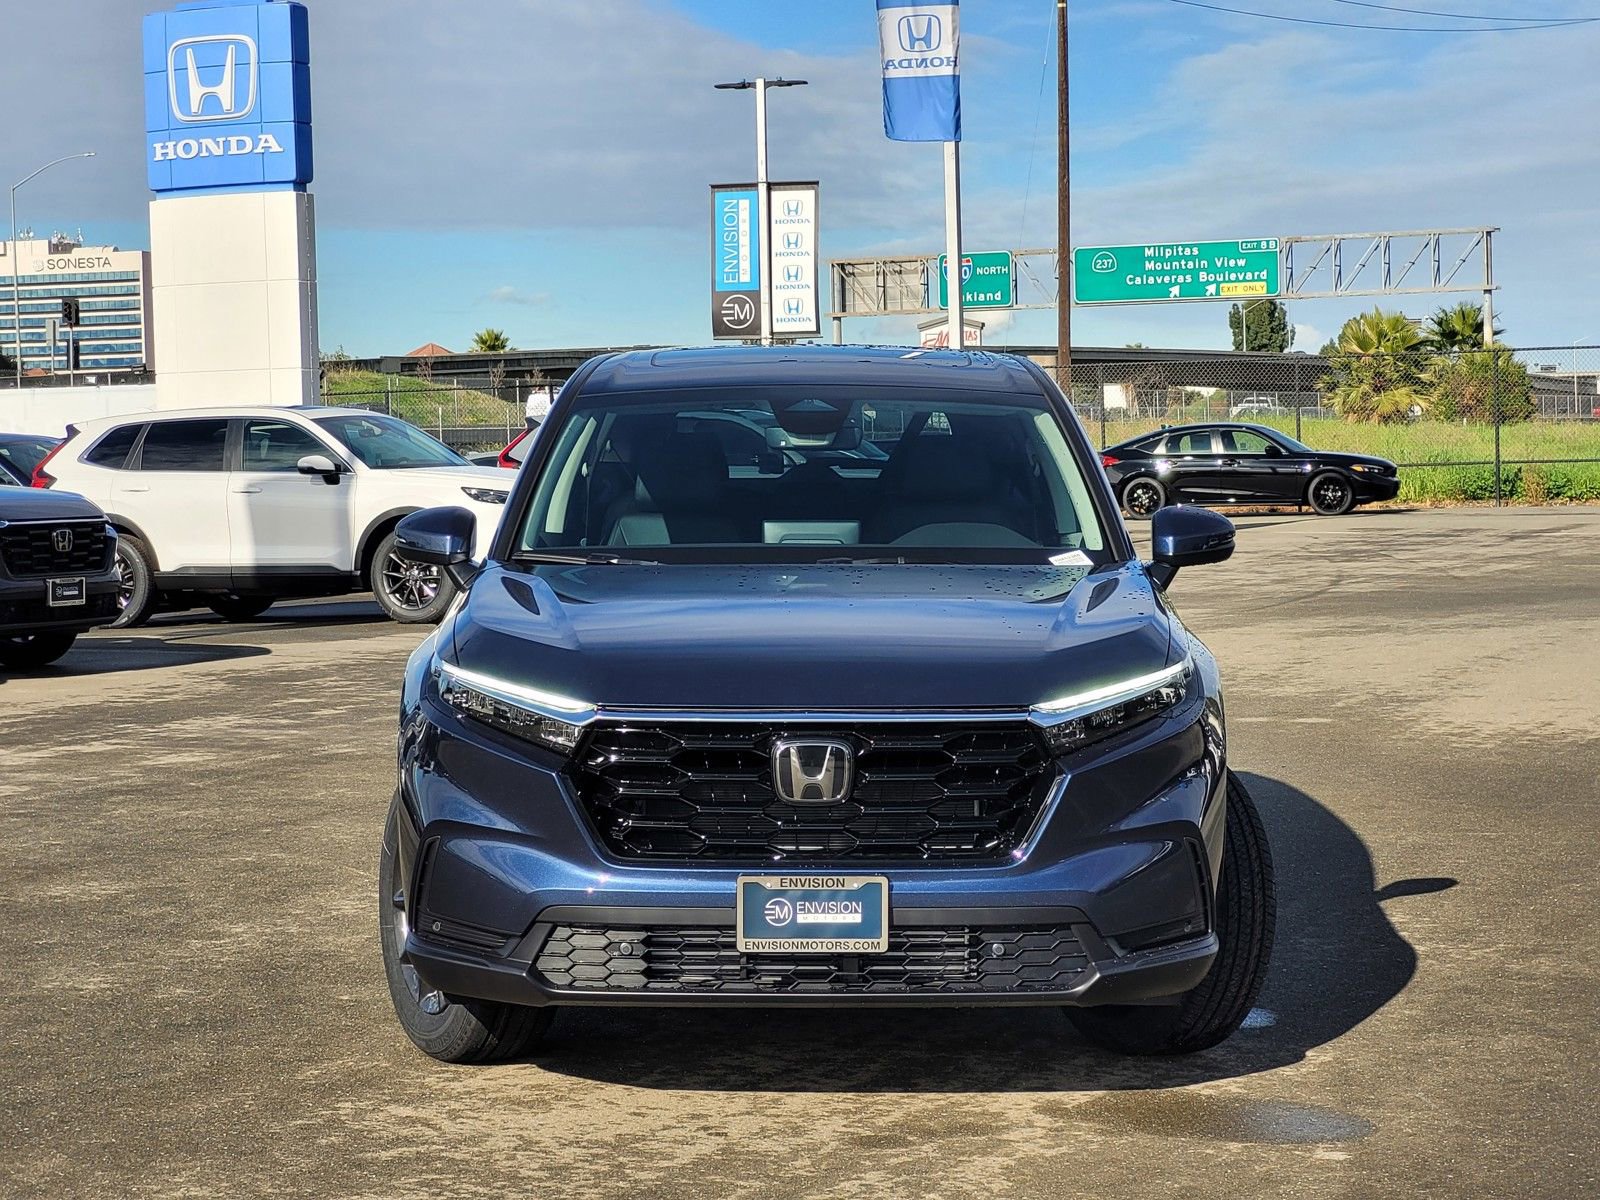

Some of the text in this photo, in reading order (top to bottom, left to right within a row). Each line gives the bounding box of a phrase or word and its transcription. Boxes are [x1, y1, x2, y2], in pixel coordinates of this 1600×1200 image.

[153, 133, 284, 162] HONDA
[724, 199, 738, 284] ENVISION
[1144, 246, 1199, 259] Milpitas
[47, 257, 112, 270] SONESTA
[1096, 259, 1113, 269] 237
[1145, 256, 1247, 271] Mountain View
[976, 266, 1009, 275] NORTH
[1126, 269, 1268, 285] Calaveras Boulevard
[1221, 284, 1266, 293] EXIT ONLY
[962, 290, 1002, 302] kland
[780, 877, 846, 888] ENVISION
[796, 901, 862, 914] ENVISION
[744, 941, 881, 950] ENVISIONMOTORS.COM
